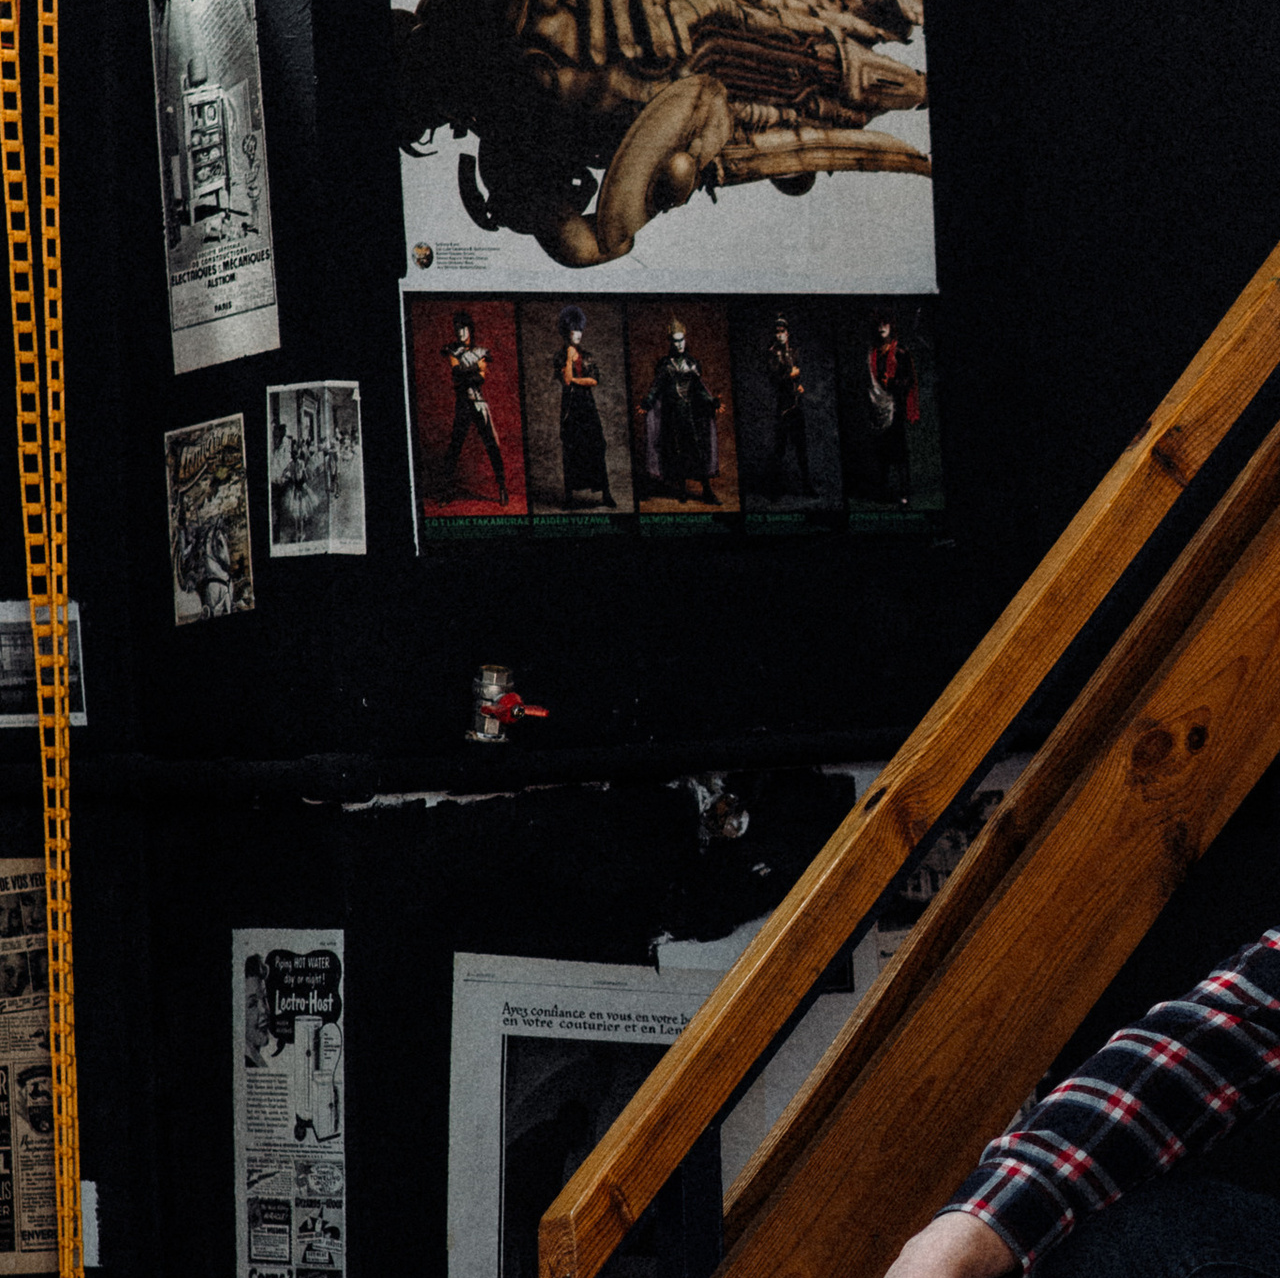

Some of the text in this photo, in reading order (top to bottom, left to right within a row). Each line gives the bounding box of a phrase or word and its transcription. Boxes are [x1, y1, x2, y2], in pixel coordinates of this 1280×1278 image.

[308, 956, 331, 969] WATER
[531, 1003, 586, 1020] confiance
[589, 1011, 605, 1021] en
[636, 1012, 650, 1023] en
[652, 1012, 679, 1025] votre
[503, 1017, 518, 1027] en
[521, 1016, 554, 1029] votre
[559, 1019, 621, 1033] couturier
[625, 1022, 637, 1034] et
[641, 1024, 657, 1035] en
